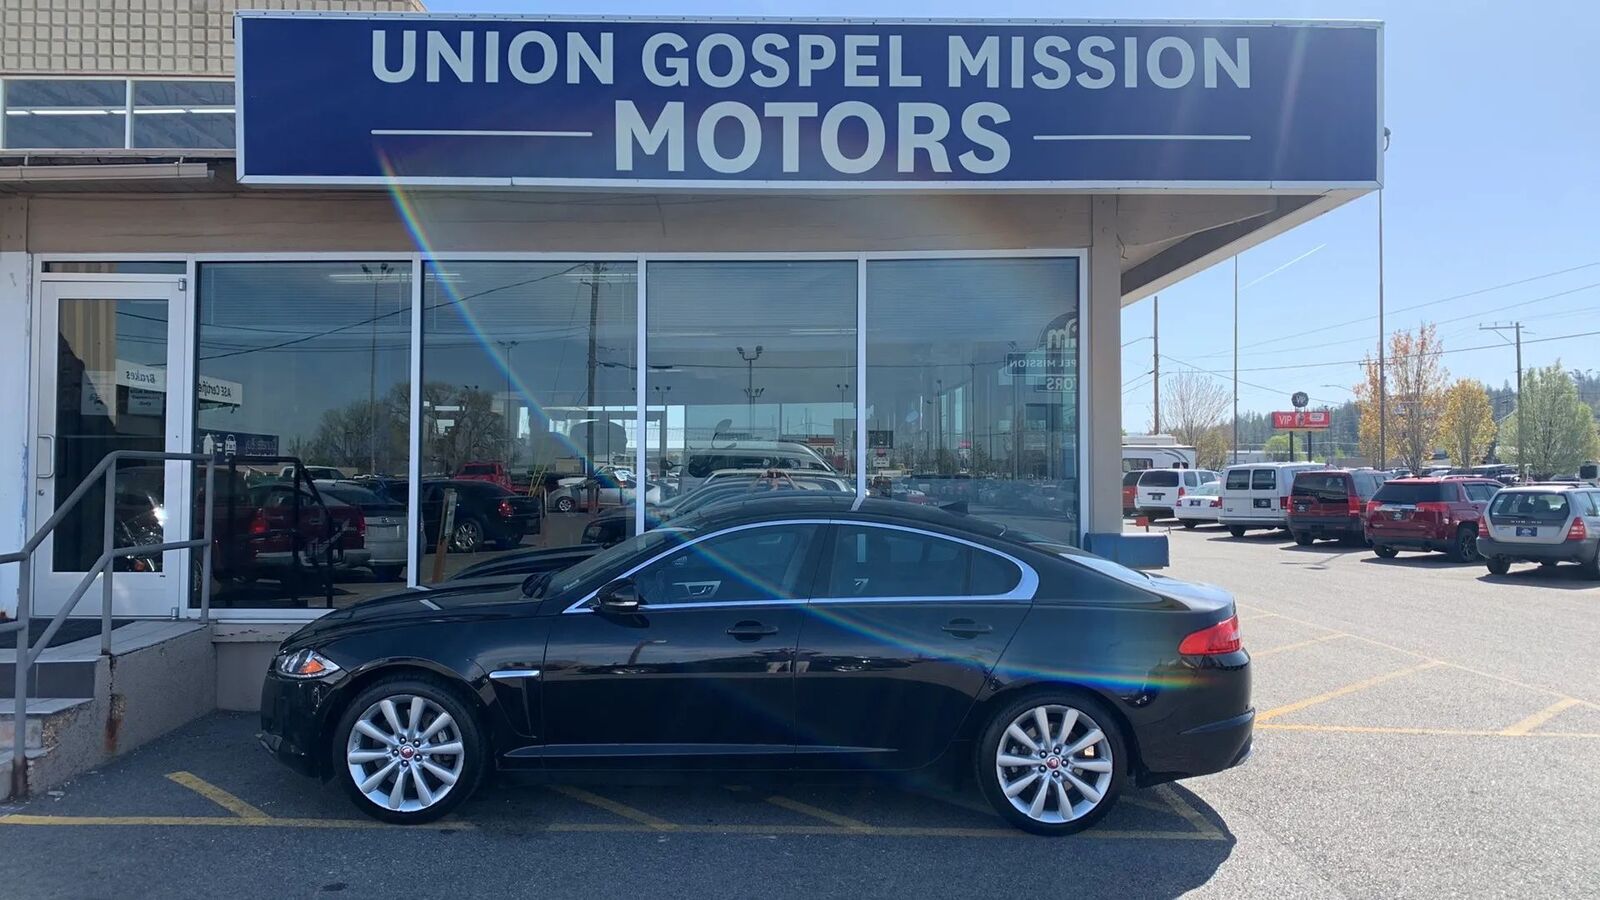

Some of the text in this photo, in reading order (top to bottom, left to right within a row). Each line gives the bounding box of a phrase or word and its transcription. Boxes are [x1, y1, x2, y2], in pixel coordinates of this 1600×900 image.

[371, 29, 1251, 90] UNION GOSPEL MISSION
[615, 100, 1012, 174] MOTORS
[1279, 415, 1292, 425] VIP
